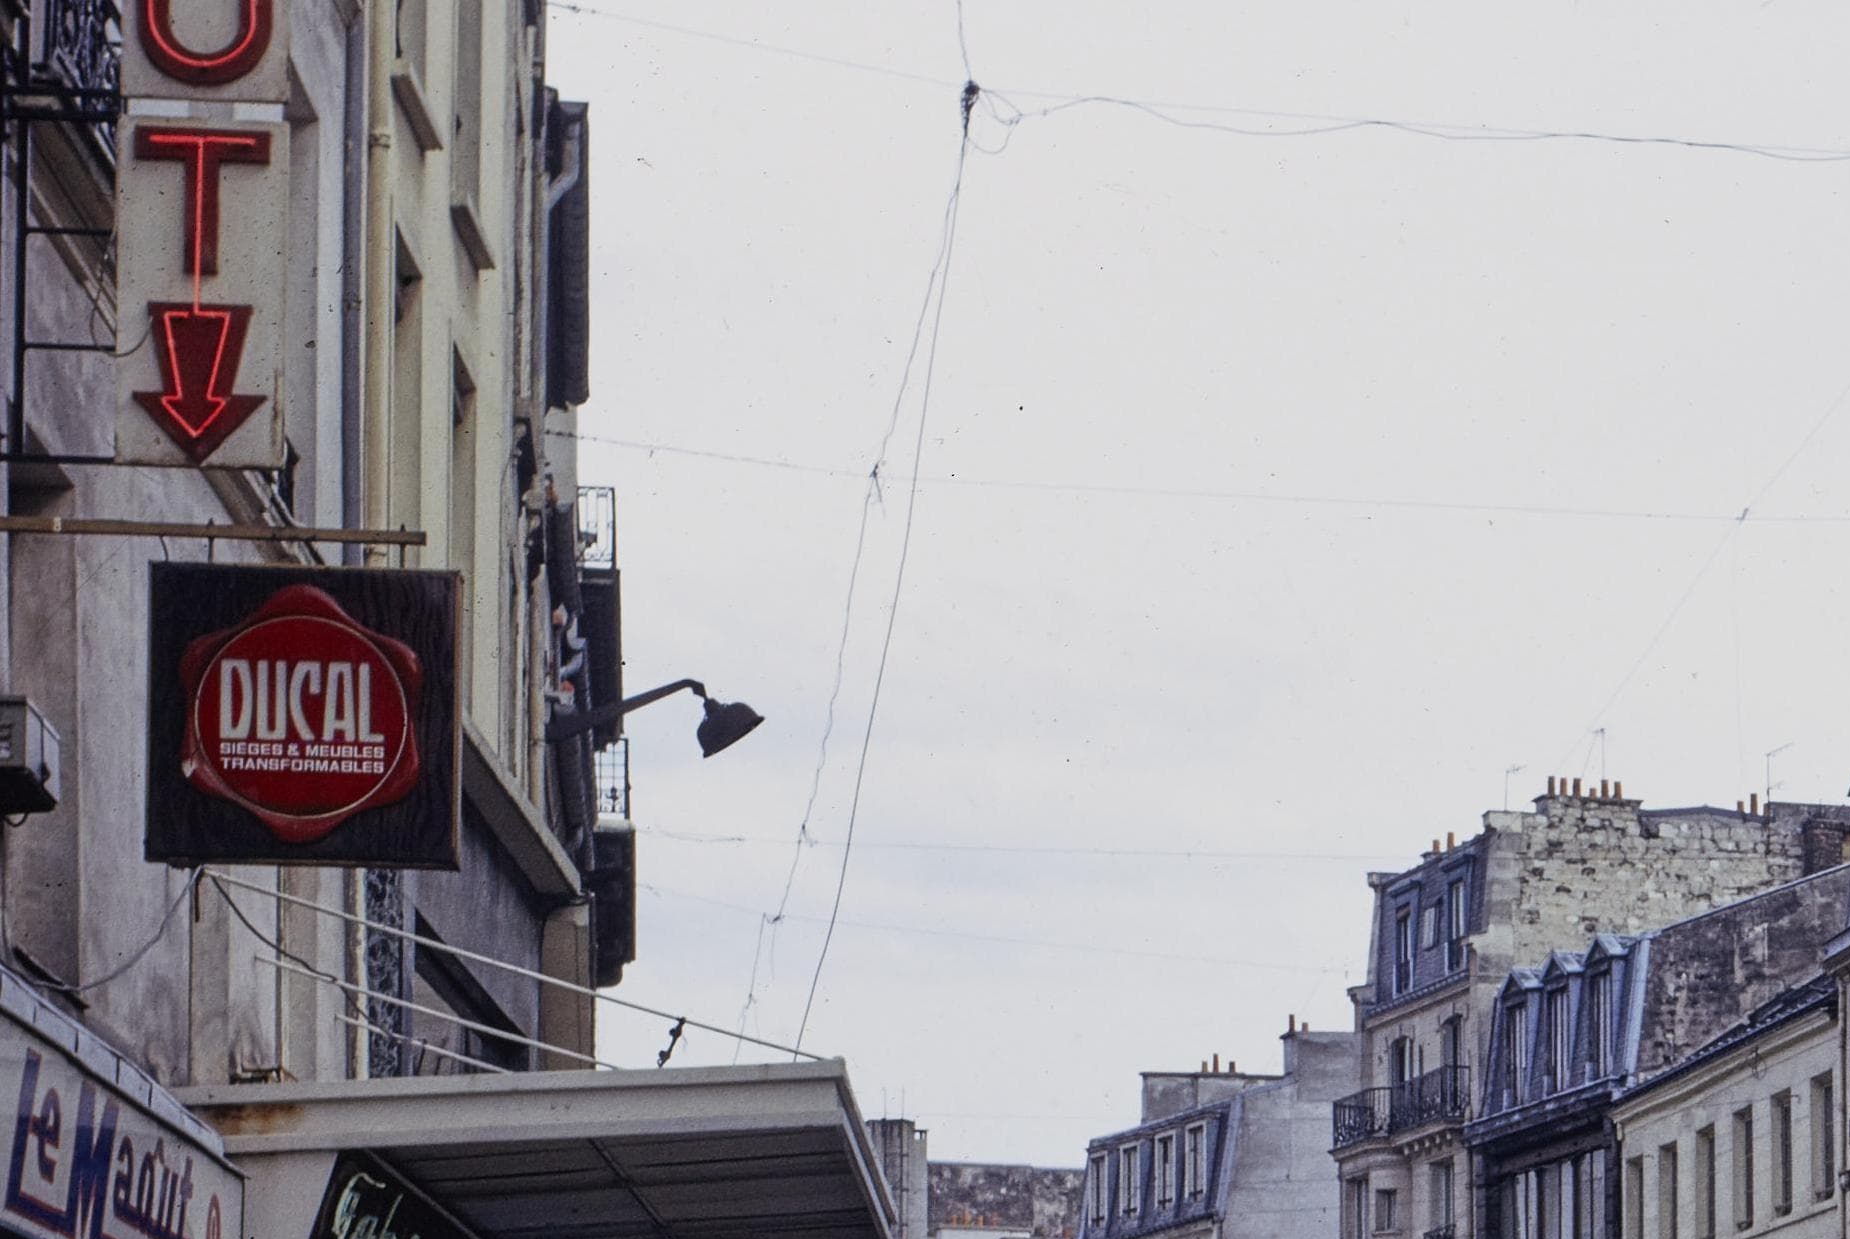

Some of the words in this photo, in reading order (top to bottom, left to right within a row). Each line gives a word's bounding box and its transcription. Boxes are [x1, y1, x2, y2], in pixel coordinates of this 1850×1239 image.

[219, 659, 385, 743] DUCAL
[220, 742, 283, 756] SIEGES
[287, 744, 300, 757] &
[305, 745, 385, 759] MEUBLES
[221, 757, 385, 774] TRANSFORMABLES
